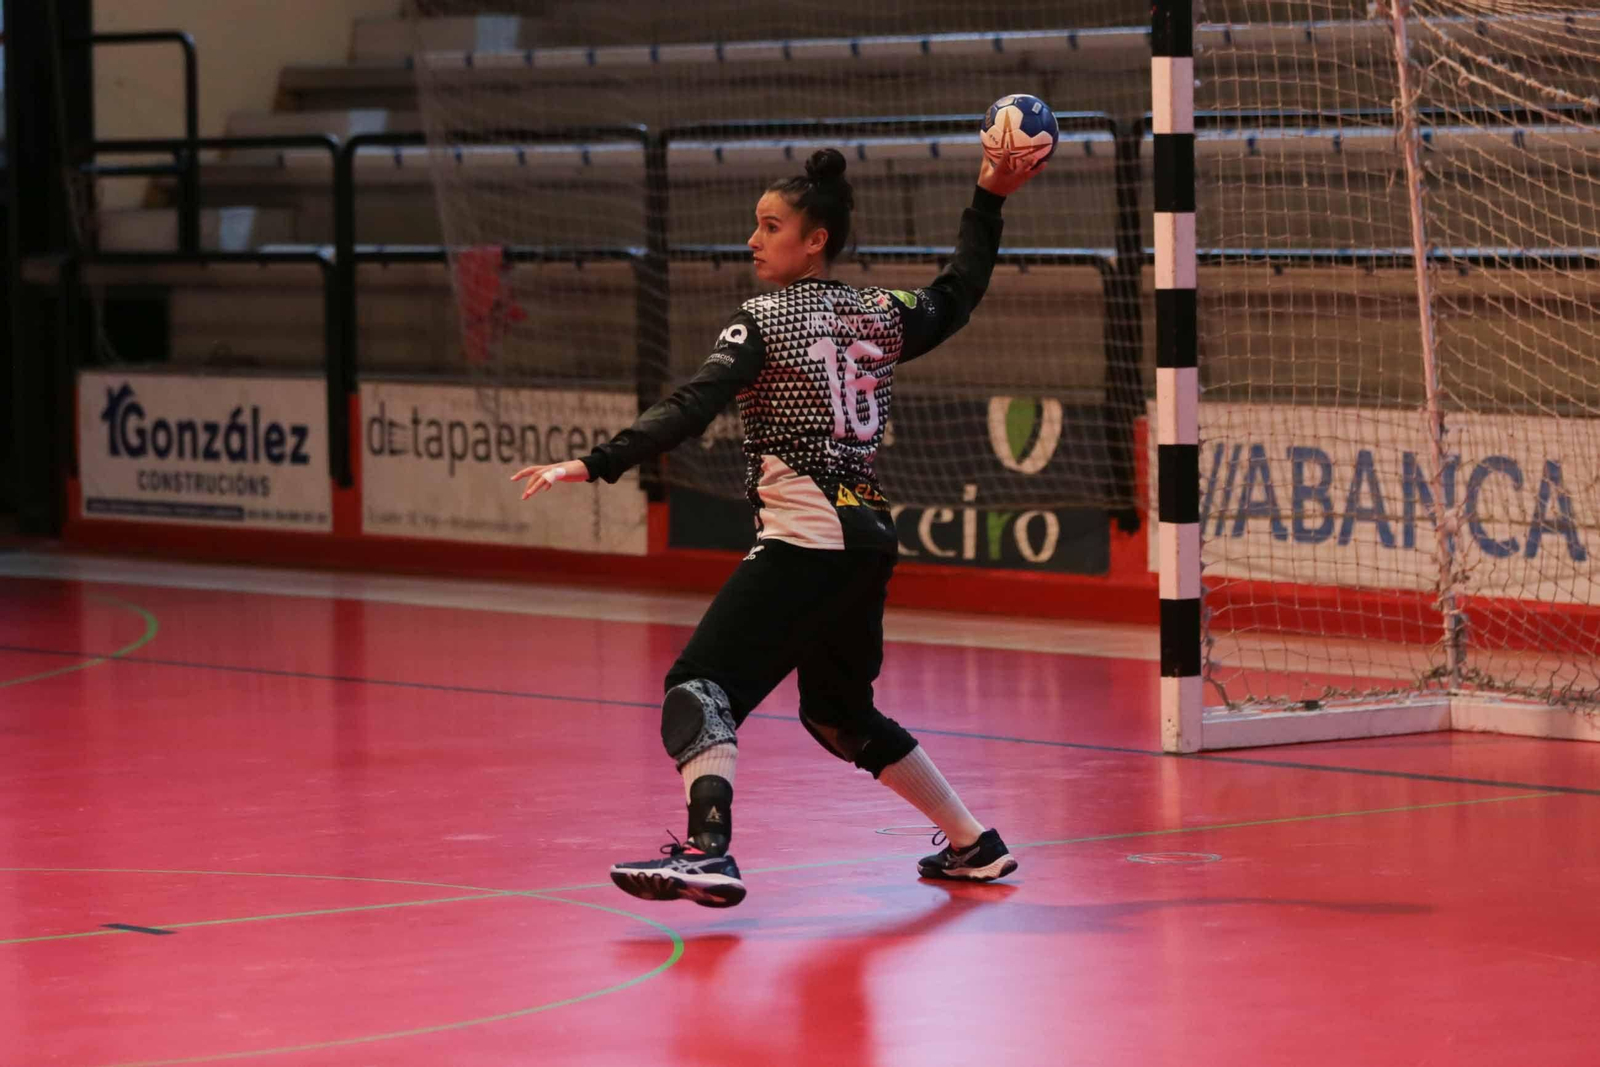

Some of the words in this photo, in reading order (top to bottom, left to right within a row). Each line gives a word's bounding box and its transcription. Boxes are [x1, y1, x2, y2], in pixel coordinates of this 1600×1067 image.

[807, 337, 883, 441] 16
[120, 402, 310, 465] González
[137, 470, 271, 497] CONSTRUCIÓNS
